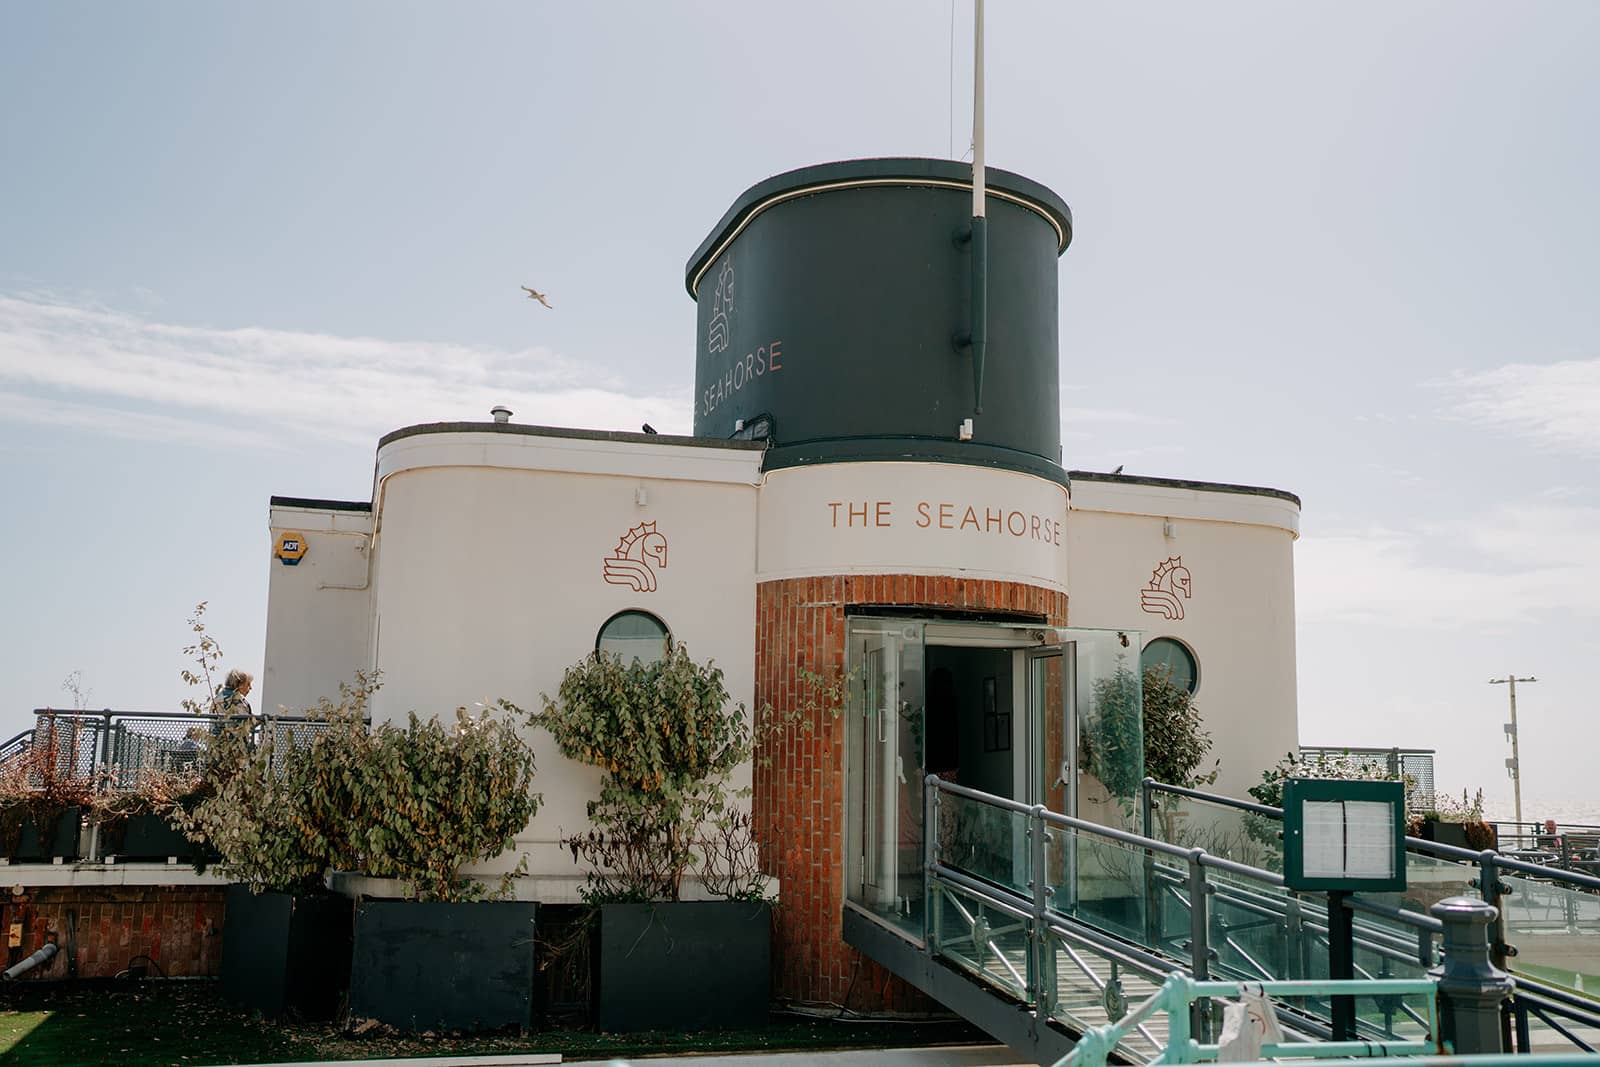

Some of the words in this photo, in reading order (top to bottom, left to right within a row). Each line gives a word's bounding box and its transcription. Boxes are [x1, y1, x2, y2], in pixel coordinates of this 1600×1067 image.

[703, 340, 782, 417] SEAHORSE
[283, 541, 299, 551] ADT
[828, 502, 892, 527] THE
[915, 502, 1061, 547] SEAHORSE
